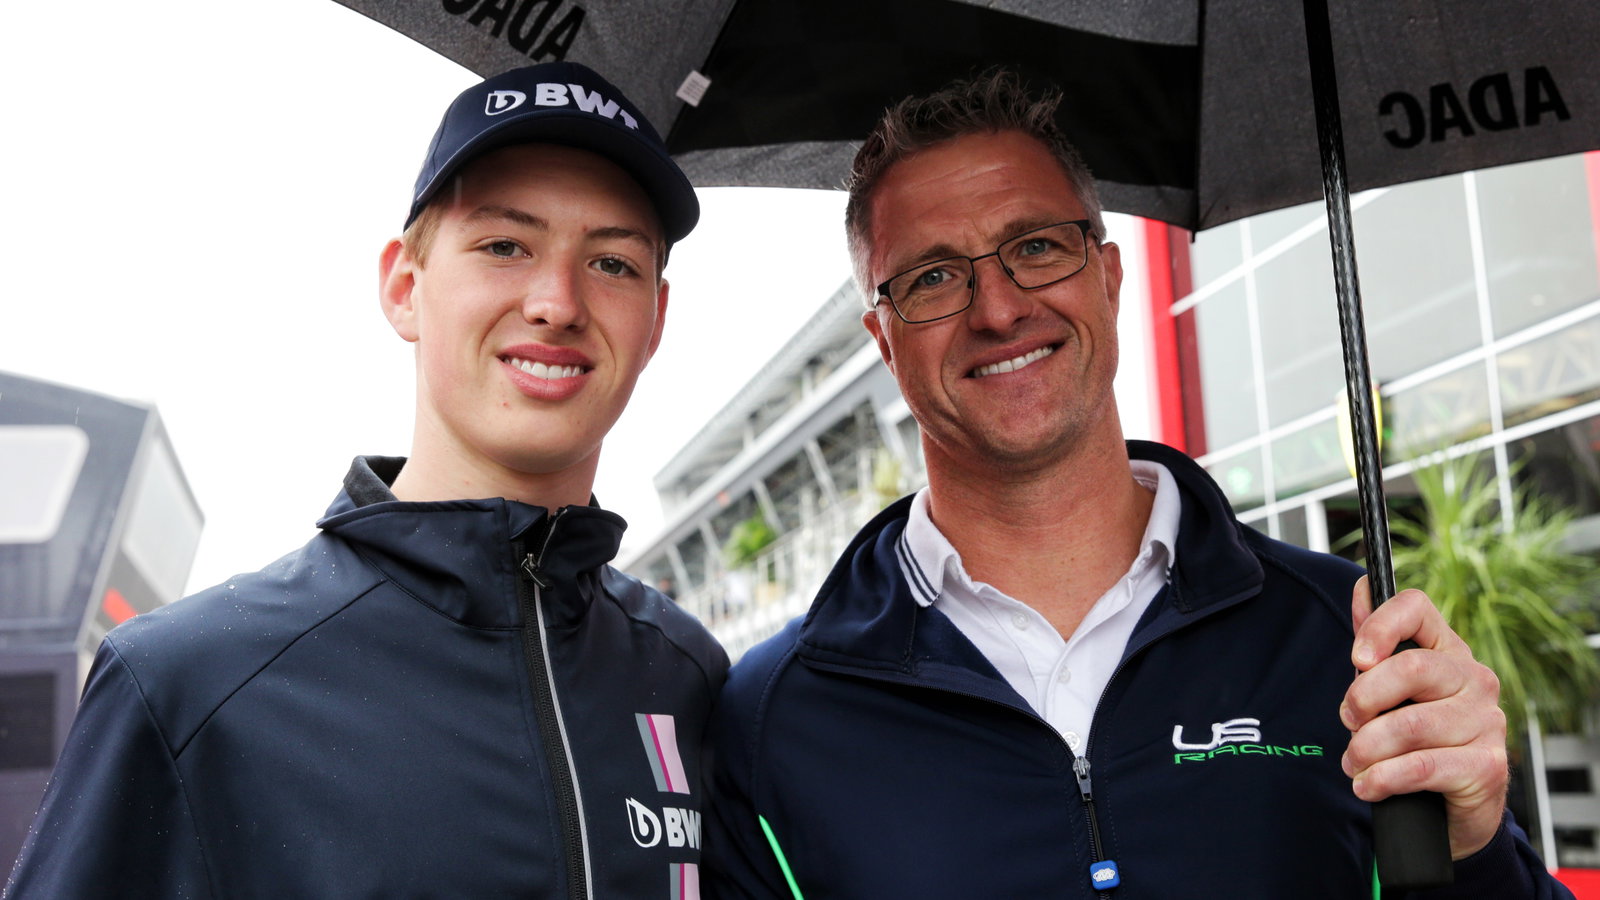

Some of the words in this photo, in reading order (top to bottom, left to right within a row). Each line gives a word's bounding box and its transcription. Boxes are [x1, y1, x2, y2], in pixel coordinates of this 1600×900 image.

[1172, 718, 1262, 750] US
[1174, 744, 1324, 764] RACING
[662, 806, 702, 851] BW
